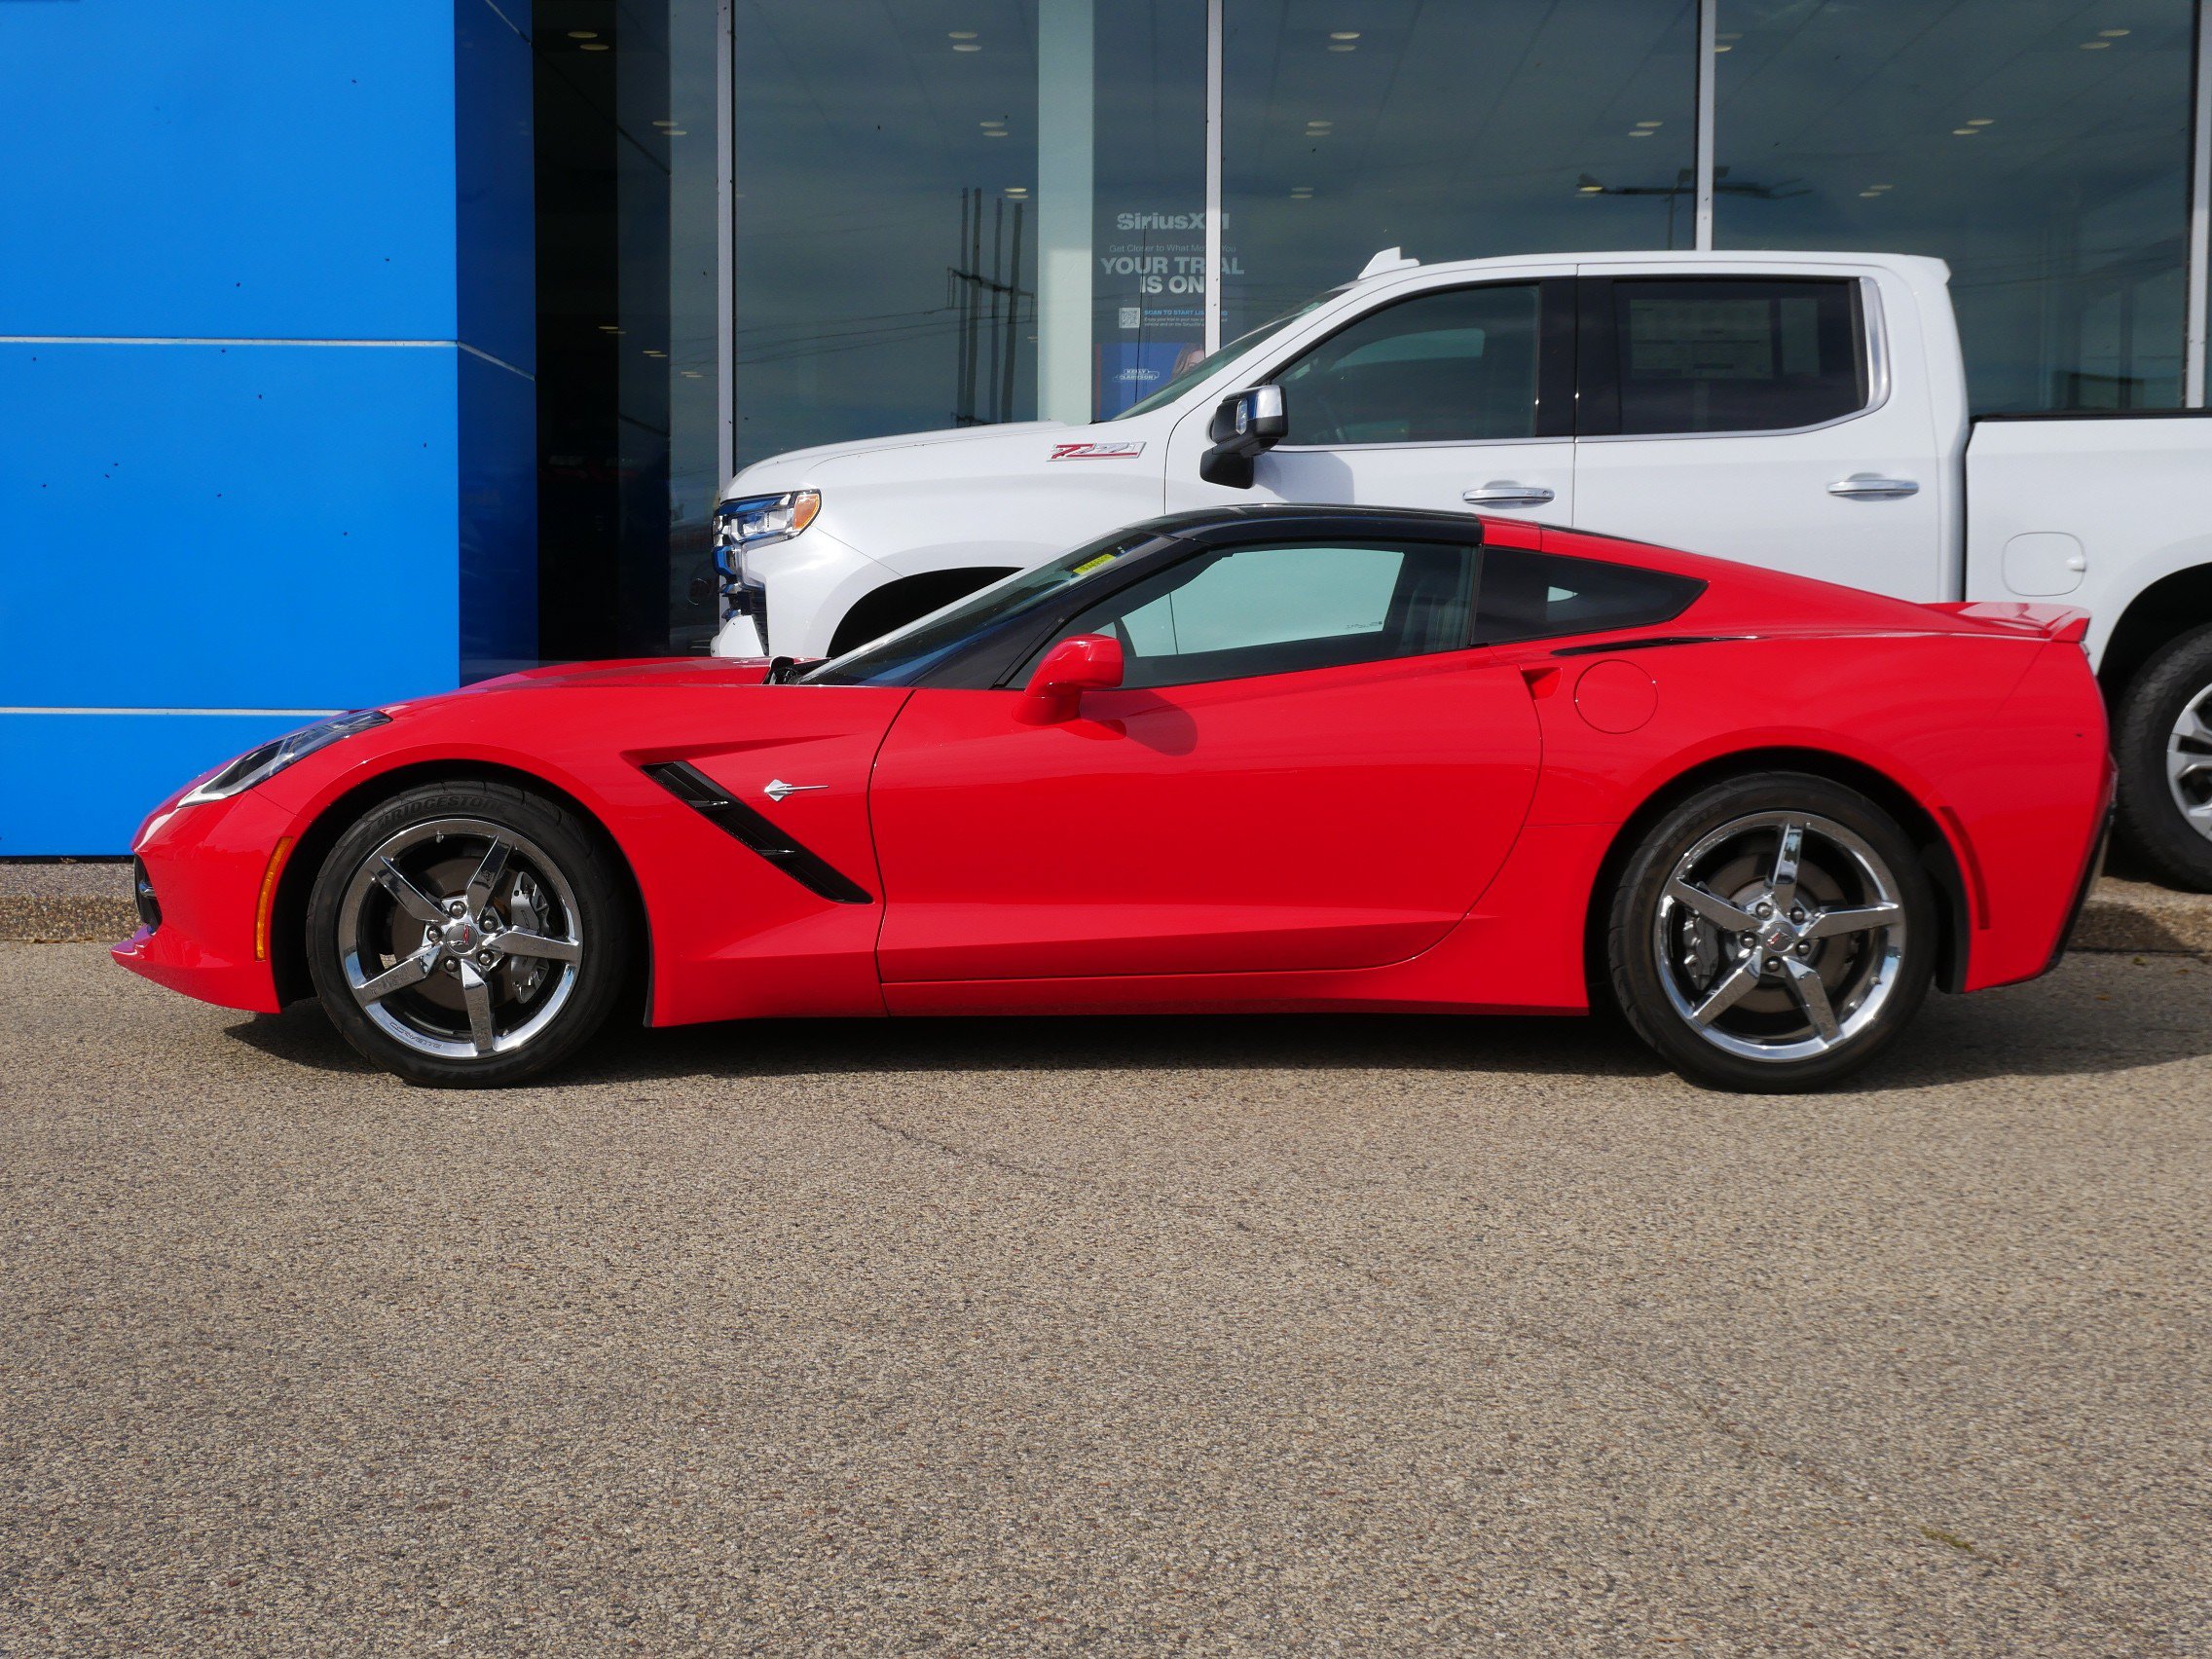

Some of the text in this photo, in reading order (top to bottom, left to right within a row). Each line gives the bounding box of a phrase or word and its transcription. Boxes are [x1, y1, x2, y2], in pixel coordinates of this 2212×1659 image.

[1109, 243, 1124, 252] Get
[1156, 243, 1164, 252] to
[1166, 243, 1189, 252] What
[1100, 256, 1245, 275] YOUR TRAL
[1139, 276, 1204, 294] IS ON
